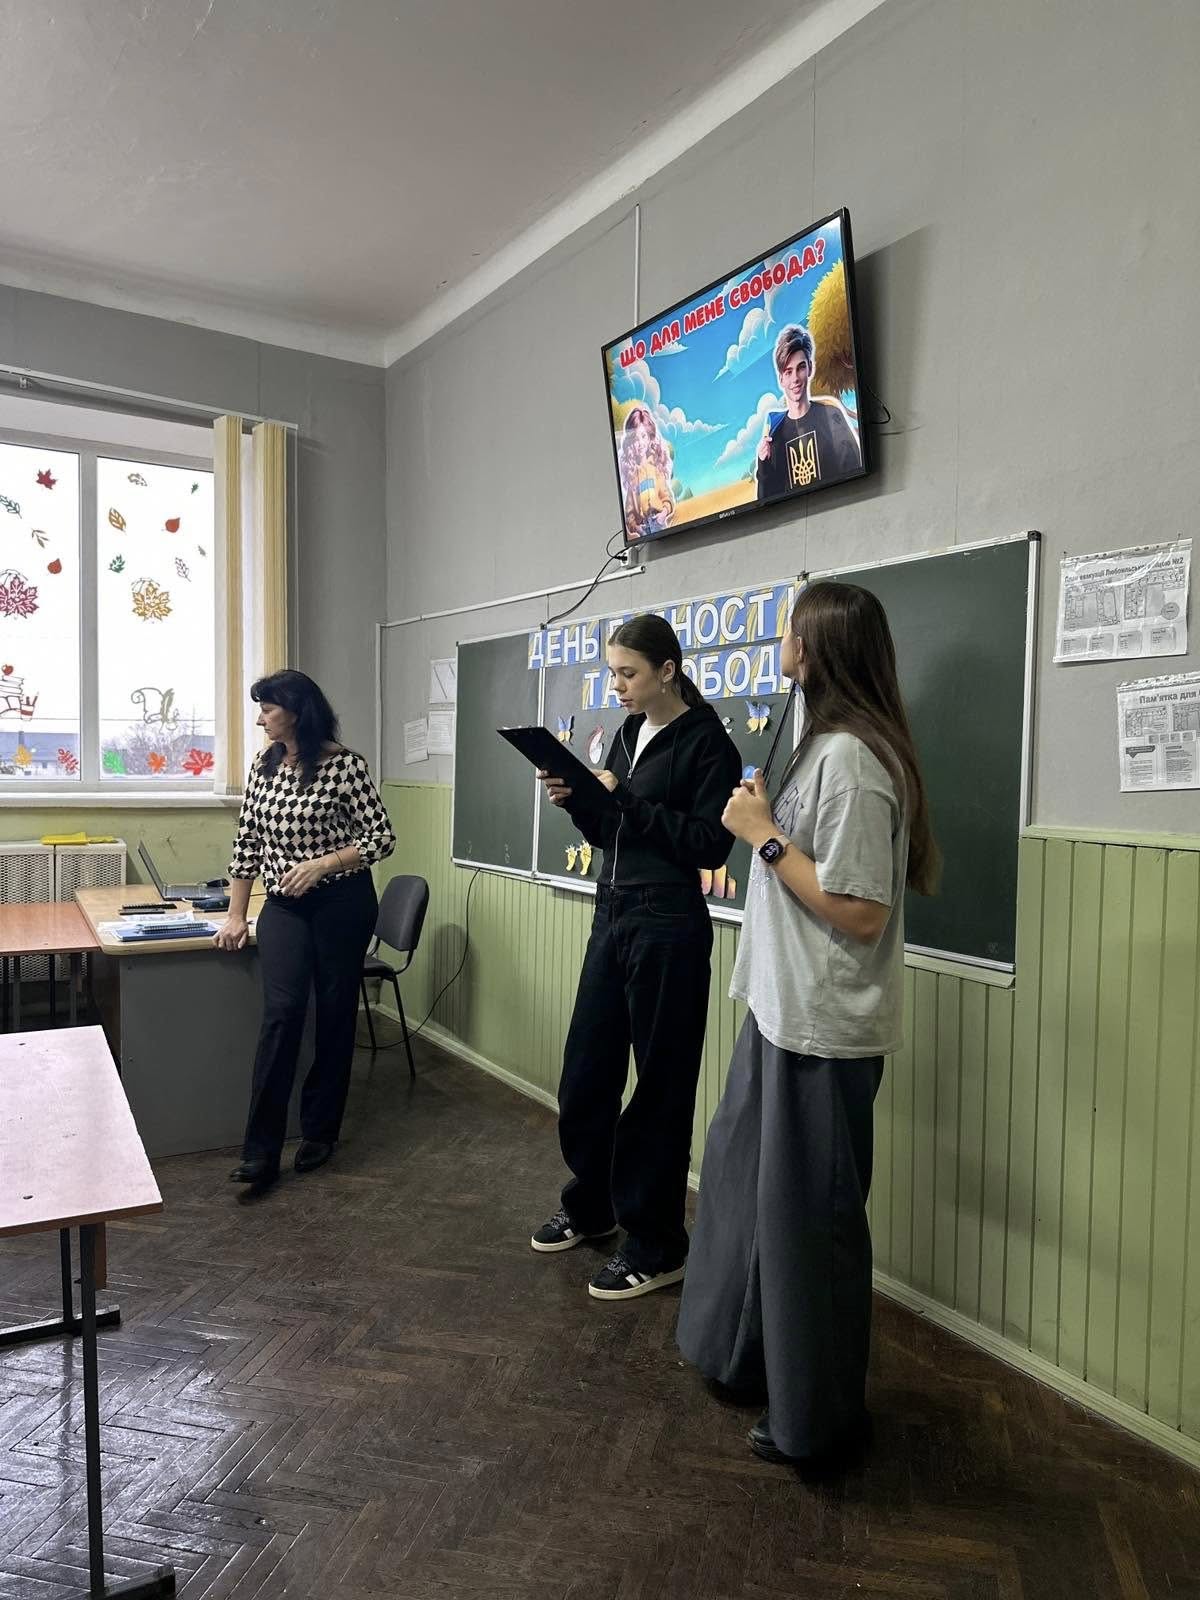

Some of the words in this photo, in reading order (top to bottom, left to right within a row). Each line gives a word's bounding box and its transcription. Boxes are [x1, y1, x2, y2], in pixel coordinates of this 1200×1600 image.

[650, 321, 680, 356] ДЛЯ
[684, 296, 725, 335] МЕНЕ
[729, 238, 825, 309] СВОБОДА?
[529, 625, 598, 668] ДЕНЬ
[609, 586, 795, 647] НОСТІ
[682, 644, 793, 697] ОБОД
[1140, 693, 1178, 704] Пам'ятка
[1180, 691, 1197, 701] для
